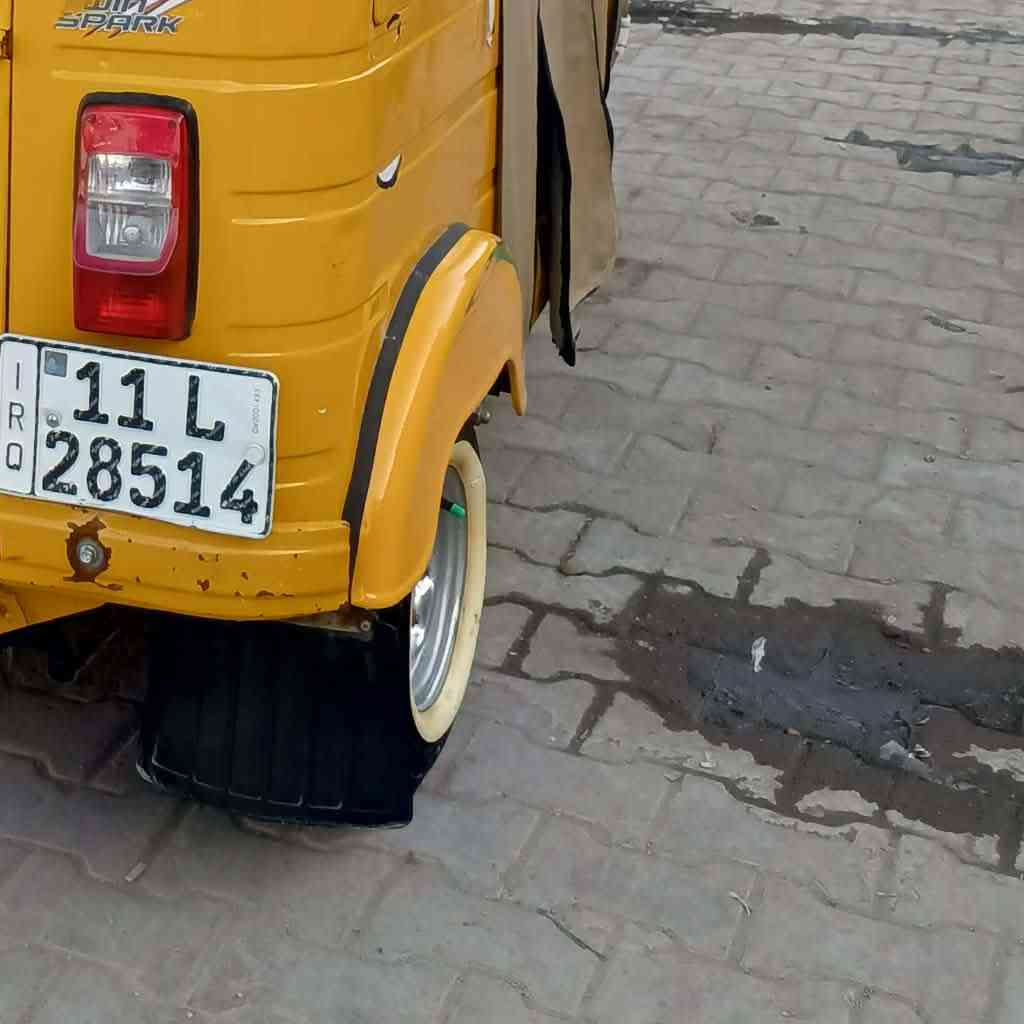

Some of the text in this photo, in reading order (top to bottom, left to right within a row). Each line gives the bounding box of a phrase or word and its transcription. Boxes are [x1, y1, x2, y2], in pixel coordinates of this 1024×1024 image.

[55, 13, 183, 34] SPARK
[73, 361, 154, 432] 11
[185, 374, 226, 442] L
[42, 429, 260, 525] 28514
